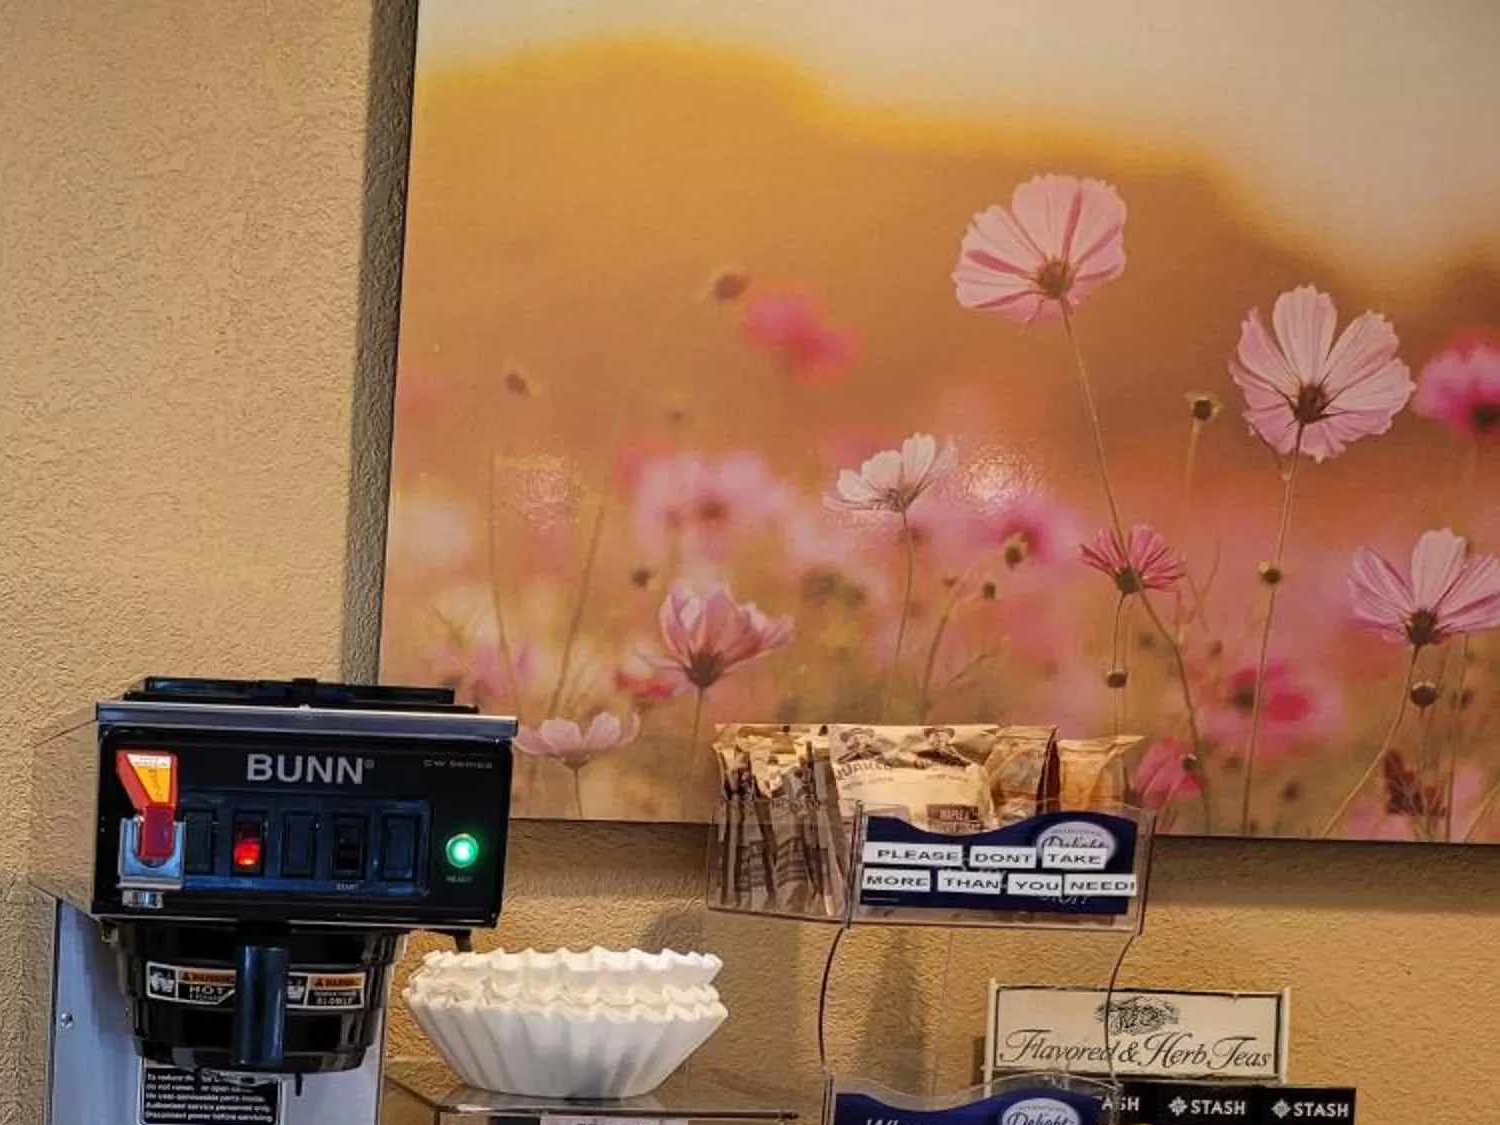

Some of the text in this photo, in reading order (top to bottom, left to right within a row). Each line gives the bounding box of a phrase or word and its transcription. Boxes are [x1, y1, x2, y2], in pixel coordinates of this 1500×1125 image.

[246, 753, 366, 786] BUNN
[877, 849, 1102, 864] PLEASE DONT TAKE
[866, 875, 929, 887] MORE
[943, 877, 1000, 889] THAN
[1015, 880, 1060, 890] YOU
[1000, 1029, 1273, 1070] Flavored & Herb Teas
[1190, 1099, 1246, 1115] STASH
[1293, 1102, 1349, 1118] STASH
